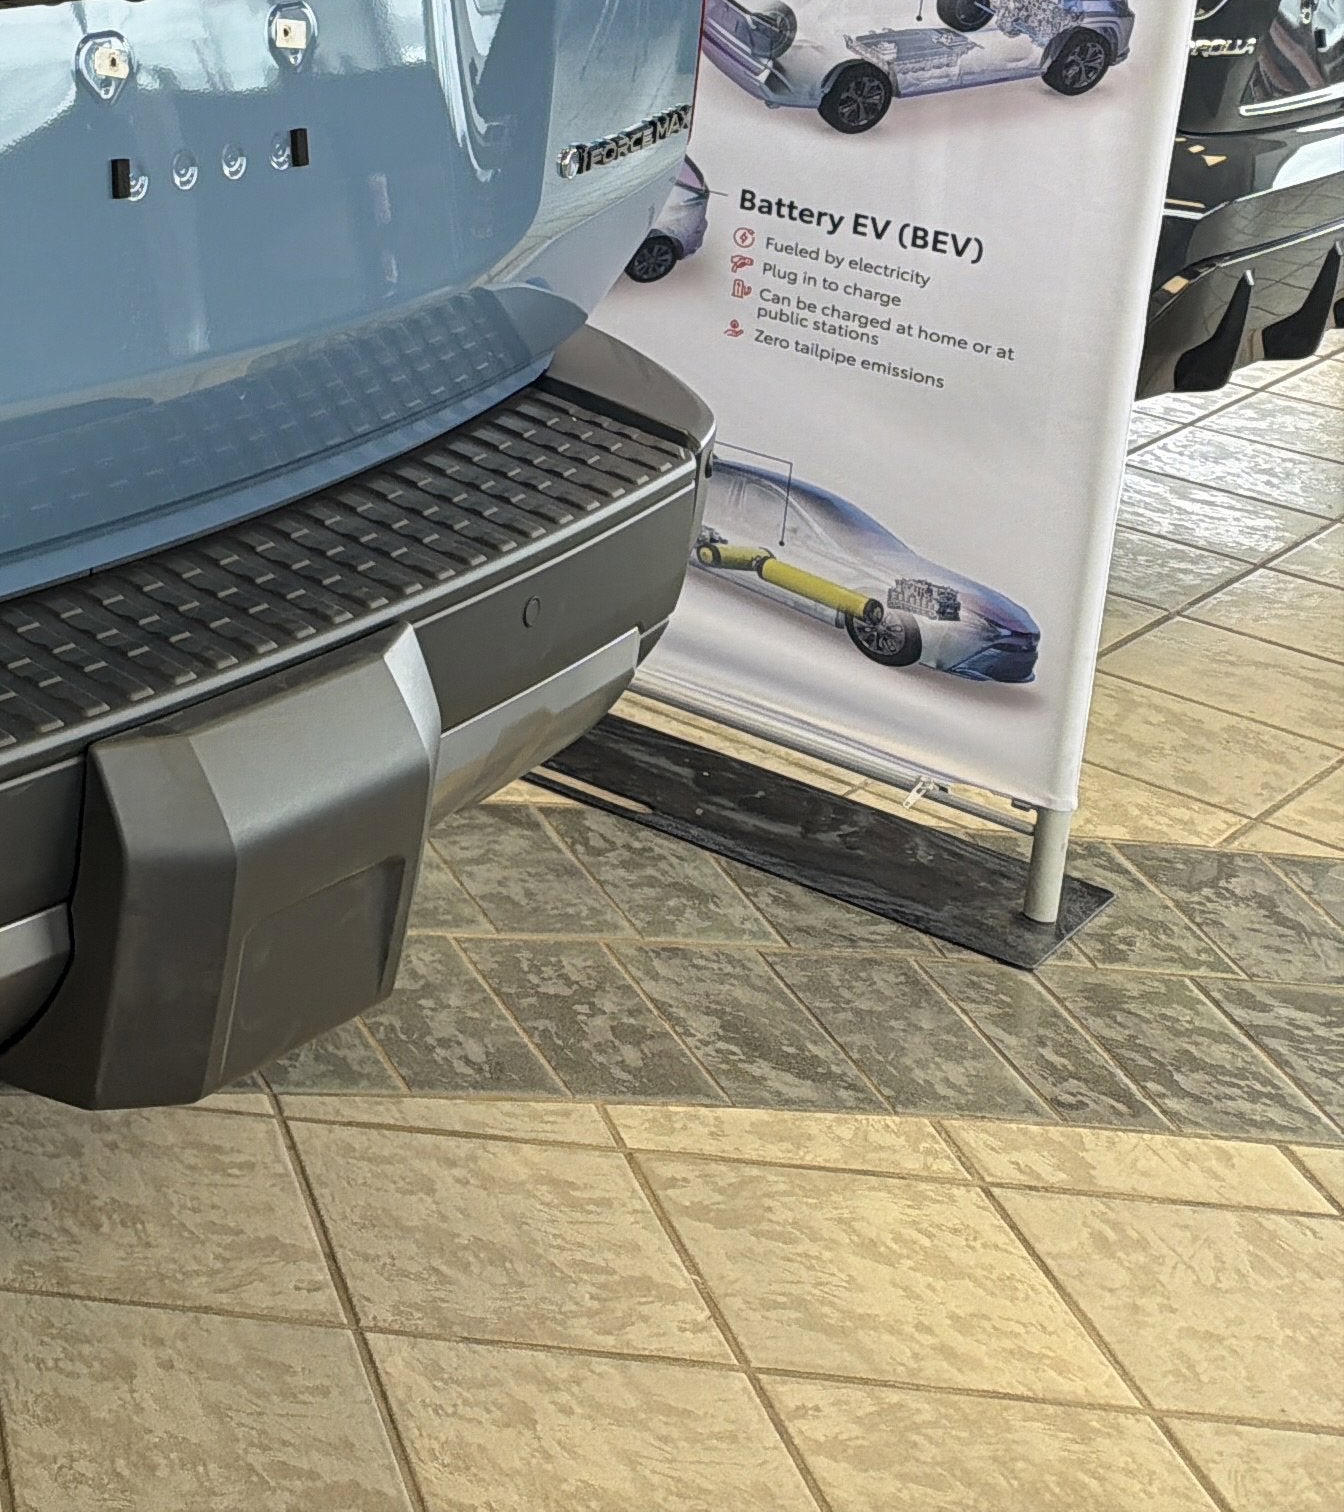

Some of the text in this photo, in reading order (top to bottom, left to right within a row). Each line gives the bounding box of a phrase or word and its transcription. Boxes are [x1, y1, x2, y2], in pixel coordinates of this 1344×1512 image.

[654, 105, 693, 140] MAX
[739, 189, 984, 264] Battery EV (BEV)
[762, 262, 902, 307] Plug in to charge
[765, 237, 931, 289] Fueled by electricity
[757, 306, 879, 346] public stations
[759, 288, 1015, 361] Can be charged at home or at
[754, 328, 945, 389] Zero tailpipe emissions
